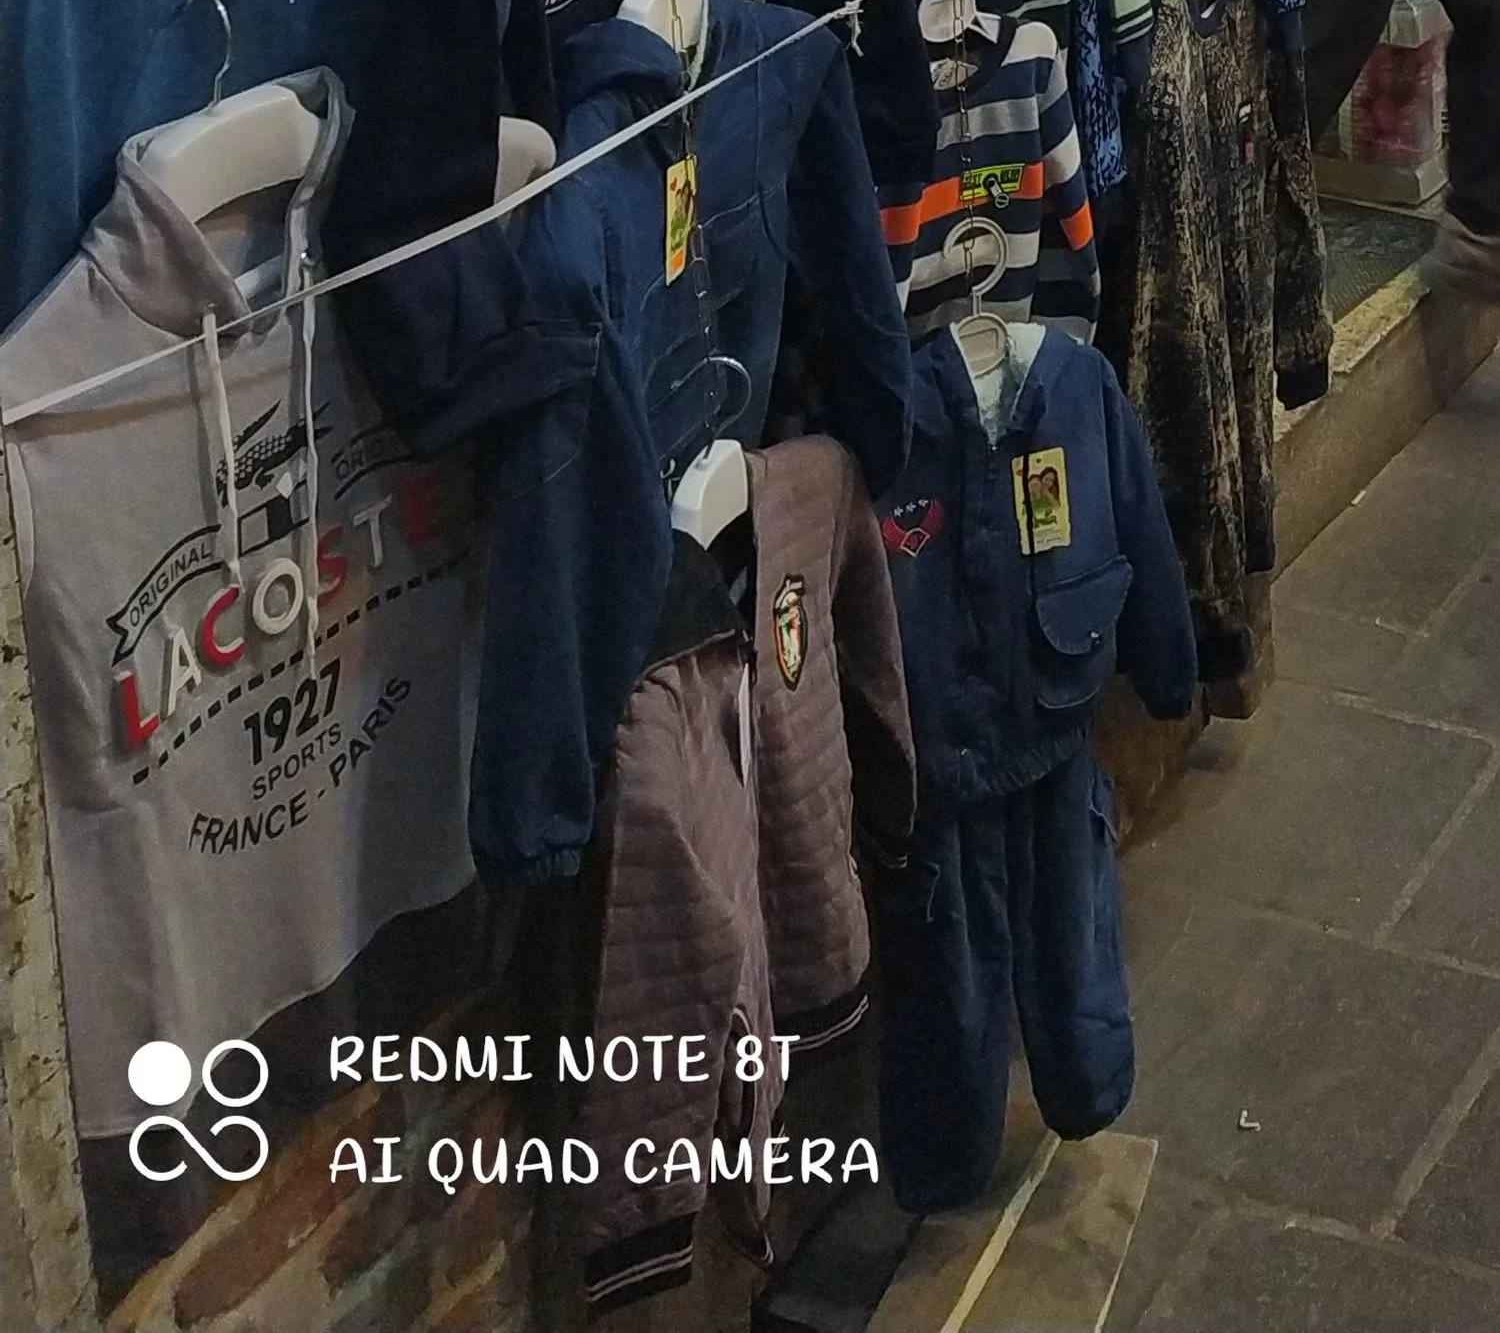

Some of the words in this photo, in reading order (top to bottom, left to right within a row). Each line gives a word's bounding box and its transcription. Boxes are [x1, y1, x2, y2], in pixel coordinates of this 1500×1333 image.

[113, 468, 444, 750] LACOSTE
[126, 546, 213, 629] ORIGINAL
[244, 658, 341, 766] 1927
[251, 723, 342, 801] SPORTS
[187, 791, 310, 856] FRANCE
[330, 677, 413, 786] PARIS
